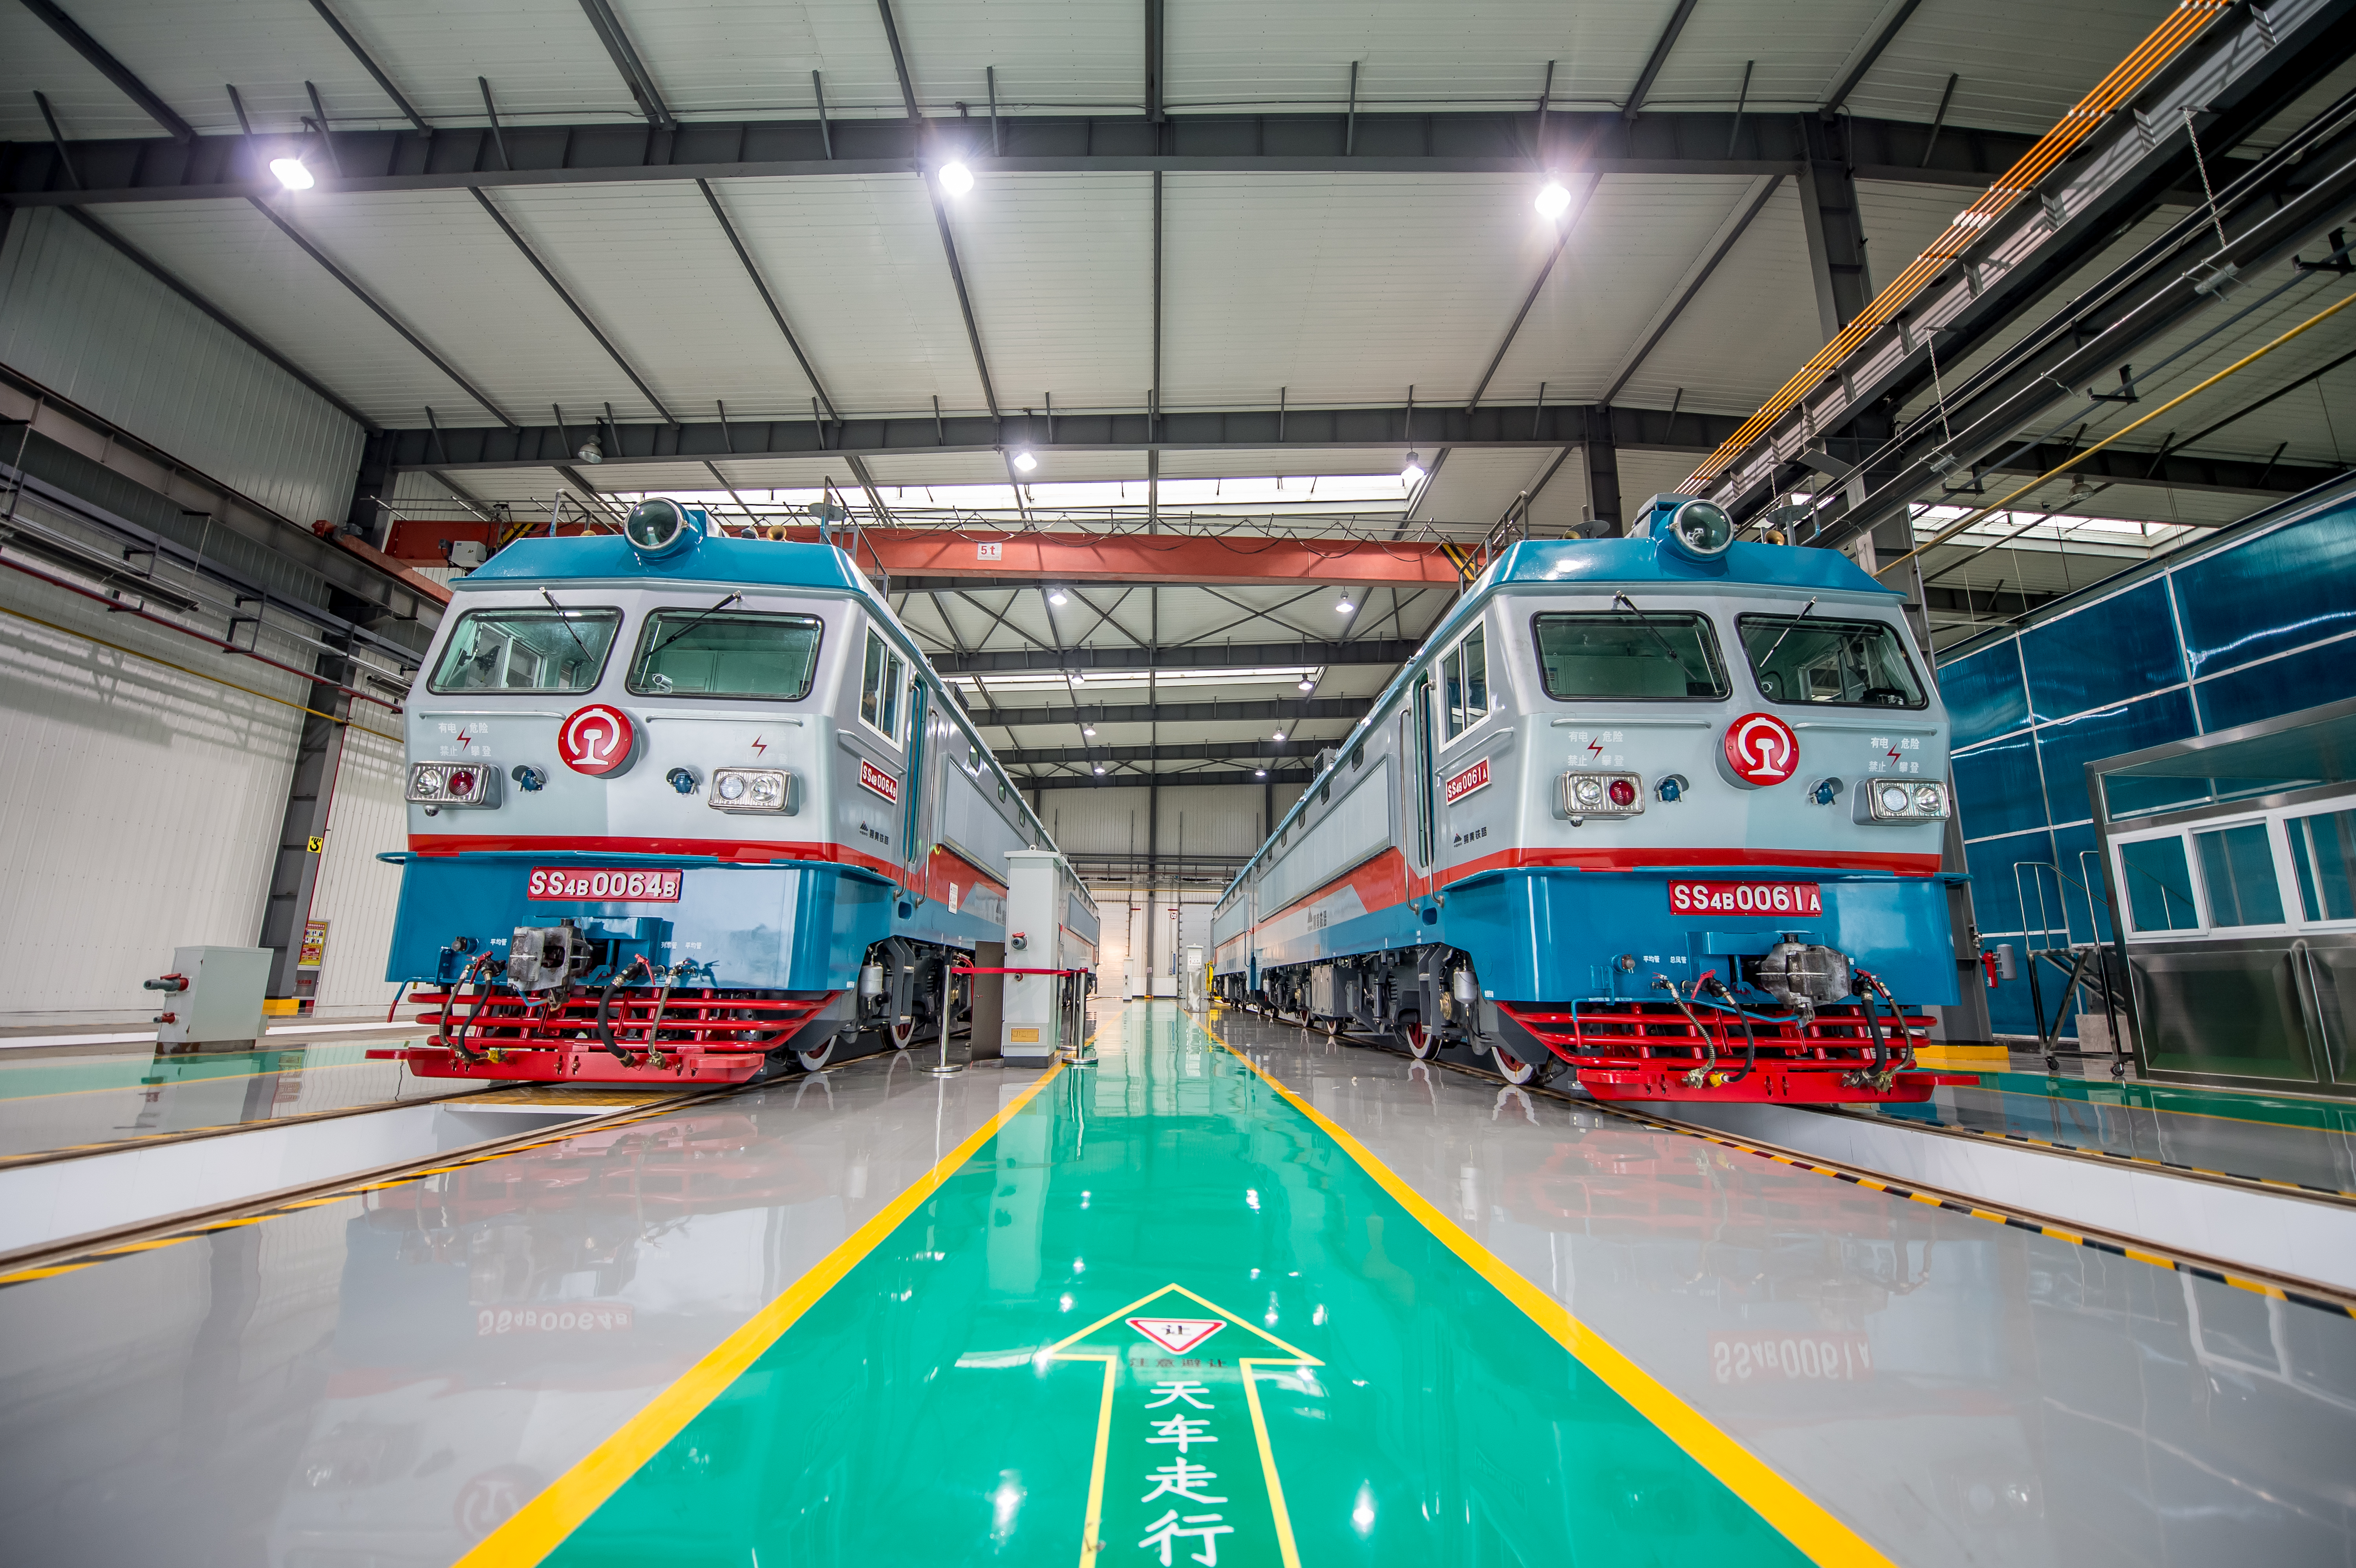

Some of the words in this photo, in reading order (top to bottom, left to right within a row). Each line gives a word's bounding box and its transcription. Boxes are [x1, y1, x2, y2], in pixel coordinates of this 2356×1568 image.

[438, 722, 457, 733] 有电
[469, 722, 488, 733] 危险
[1568, 731, 1589, 742] 有电
[1602, 731, 1624, 742] 危险
[1870, 737, 1889, 749] 有电
[1901, 738, 1920, 749] 危险
[440, 745, 458, 757] 禁止
[470, 745, 492, 757] 攀登
[1568, 755, 1588, 766] 禁止
[1601, 755, 1624, 766] 攀登
[1868, 761, 1886, 773] 禁止
[1899, 762, 1919, 773] 攀登
[862, 764, 896, 798] SS4B0064B
[1447, 768, 1487, 799] SS4B0061A
[530, 871, 677, 898] SS4B0064B
[1674, 885, 1821, 911] SS4B0061A
[1161, 1325, 1192, 1336] 让
[1129, 1358, 1228, 1369] 注意避让
[1138, 1380, 1235, 1567] 天车走行
